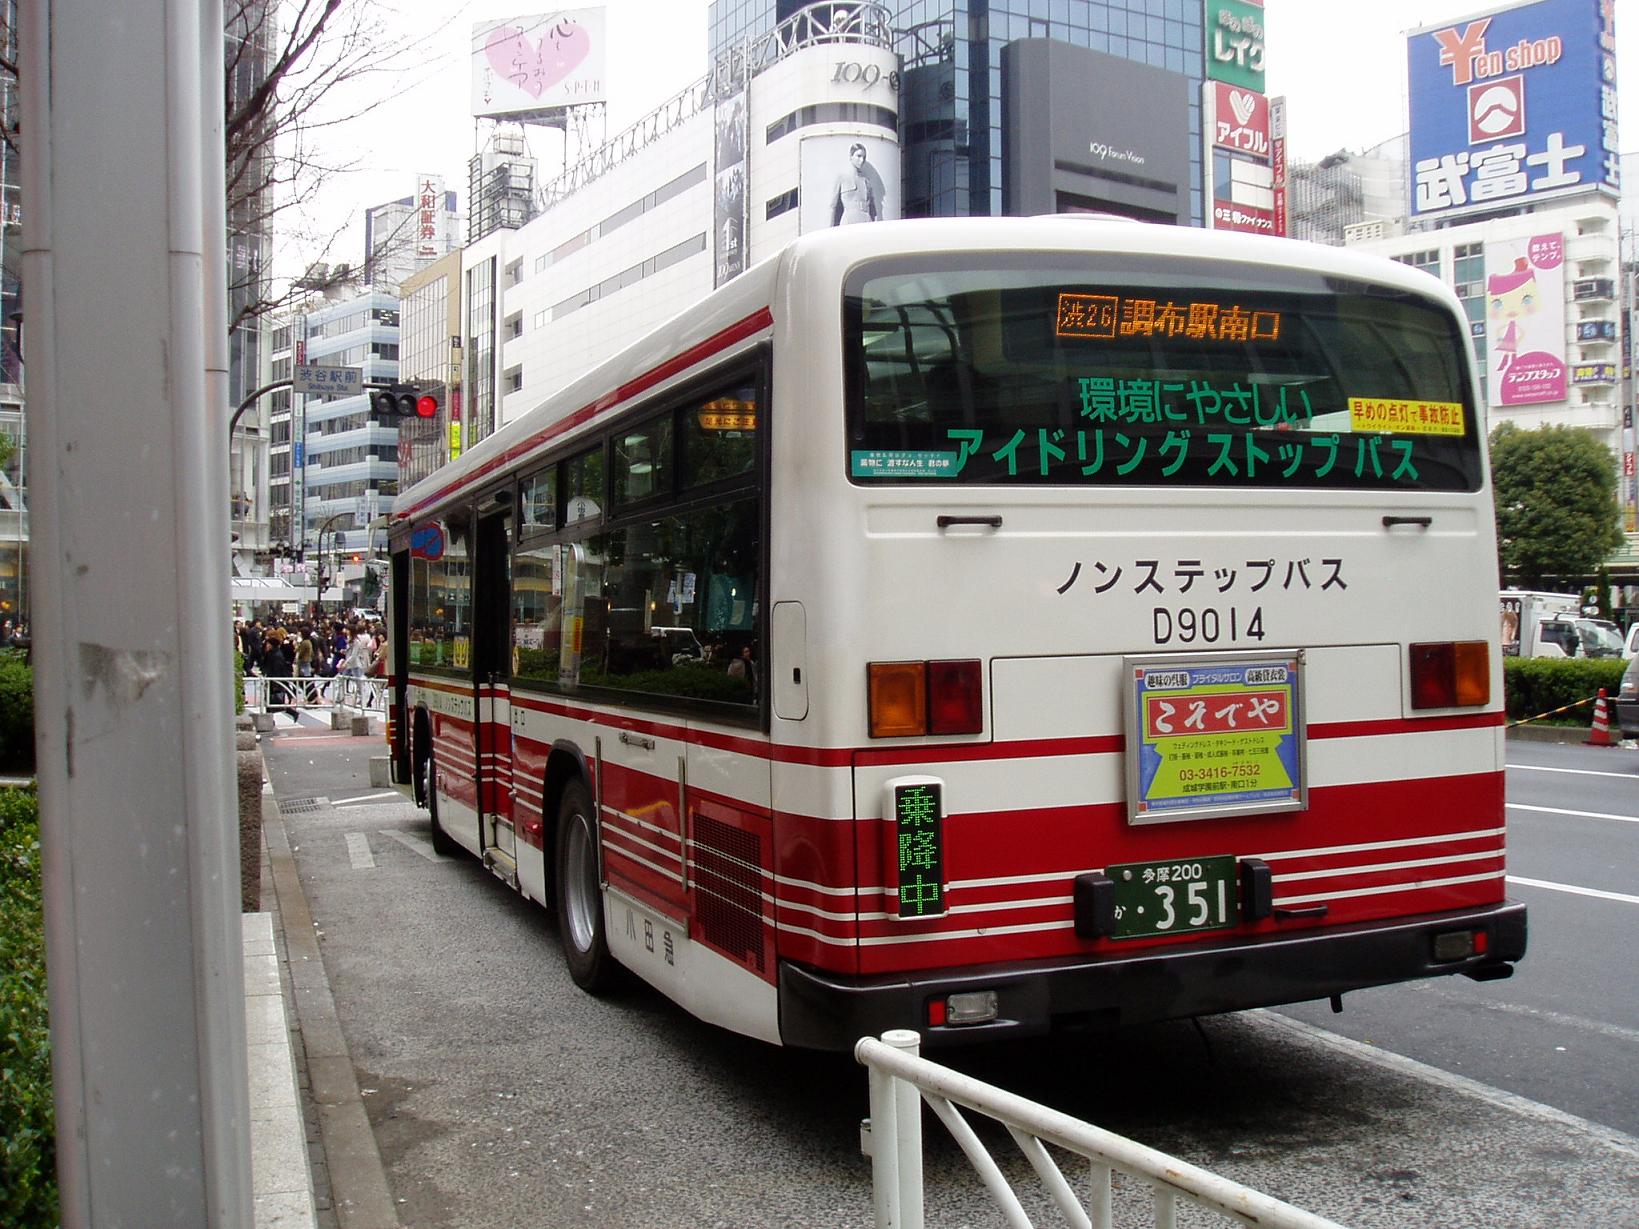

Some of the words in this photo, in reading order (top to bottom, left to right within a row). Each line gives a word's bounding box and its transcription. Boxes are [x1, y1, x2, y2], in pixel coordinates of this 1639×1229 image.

[1215, 27, 1265, 71] レイク
[1507, 36, 1561, 71] shop
[1089, 142, 1107, 160] 109
[1126, 150, 1145, 165] Vision
[1217, 121, 1267, 153] アイフル
[1416, 132, 1585, 211] 武富士
[1121, 299, 1280, 341] 調布駅南口
[300, 368, 357, 384] 渋谷駅前
[1079, 377, 1312, 425] 環境にやさしい
[1354, 401, 1460, 425] 早めの点灯で事故防止
[947, 429, 1189, 477] アイドリング
[1207, 432, 1339, 479] ストップ
[1354, 437, 1419, 480] バス
[1057, 558, 1347, 594] ノンステップバス
[1154, 607, 1265, 644] D9014
[1155, 697, 1280, 733] こそでや
[1179, 764, 1260, 782] 03-3416-7532
[899, 786, 938, 914] 乗降中
[1142, 863, 1203, 884] 多摩200
[1114, 905, 1127, 920] か
